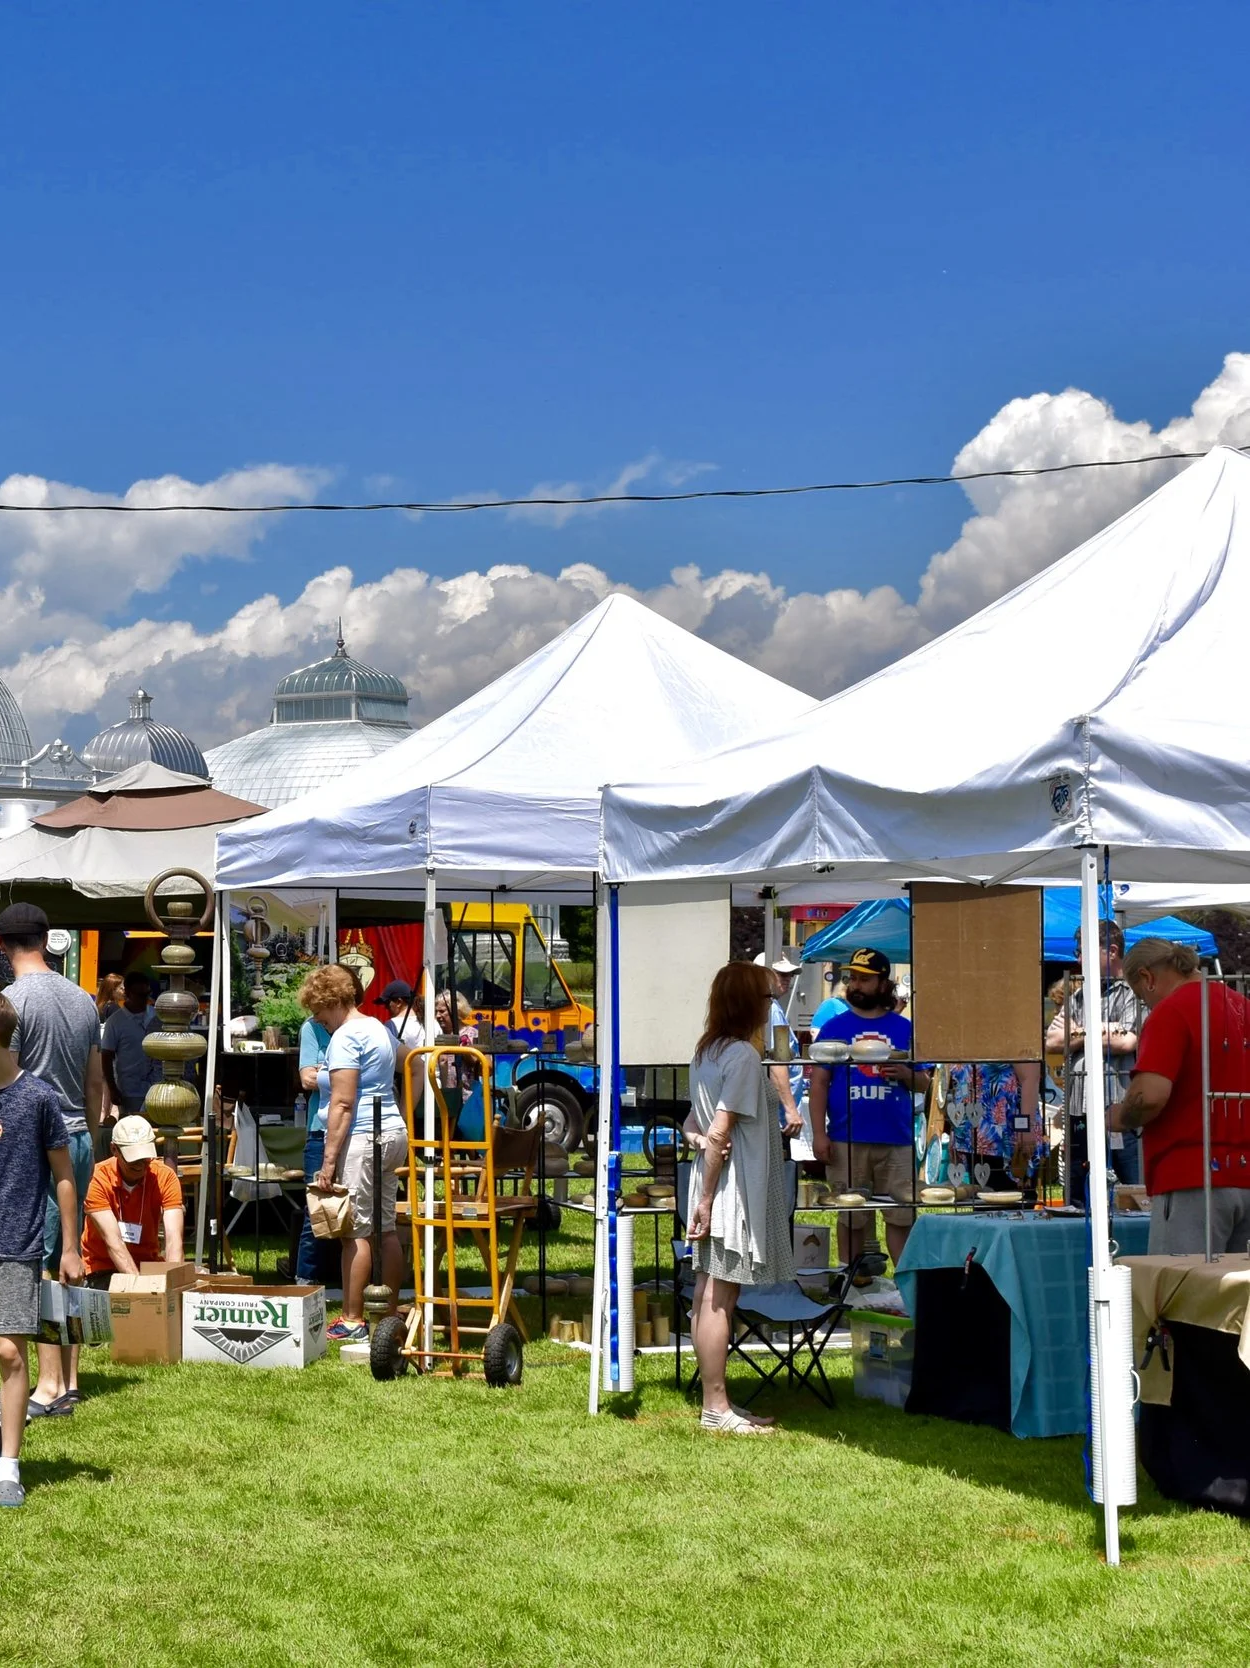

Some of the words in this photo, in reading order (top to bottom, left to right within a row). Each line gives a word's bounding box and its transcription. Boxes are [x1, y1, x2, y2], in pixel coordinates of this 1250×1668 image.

[851, 948, 876, 965] Cal
[199, 1299, 236, 1307] COMPANY
[194, 1300, 290, 1329] Rainier
